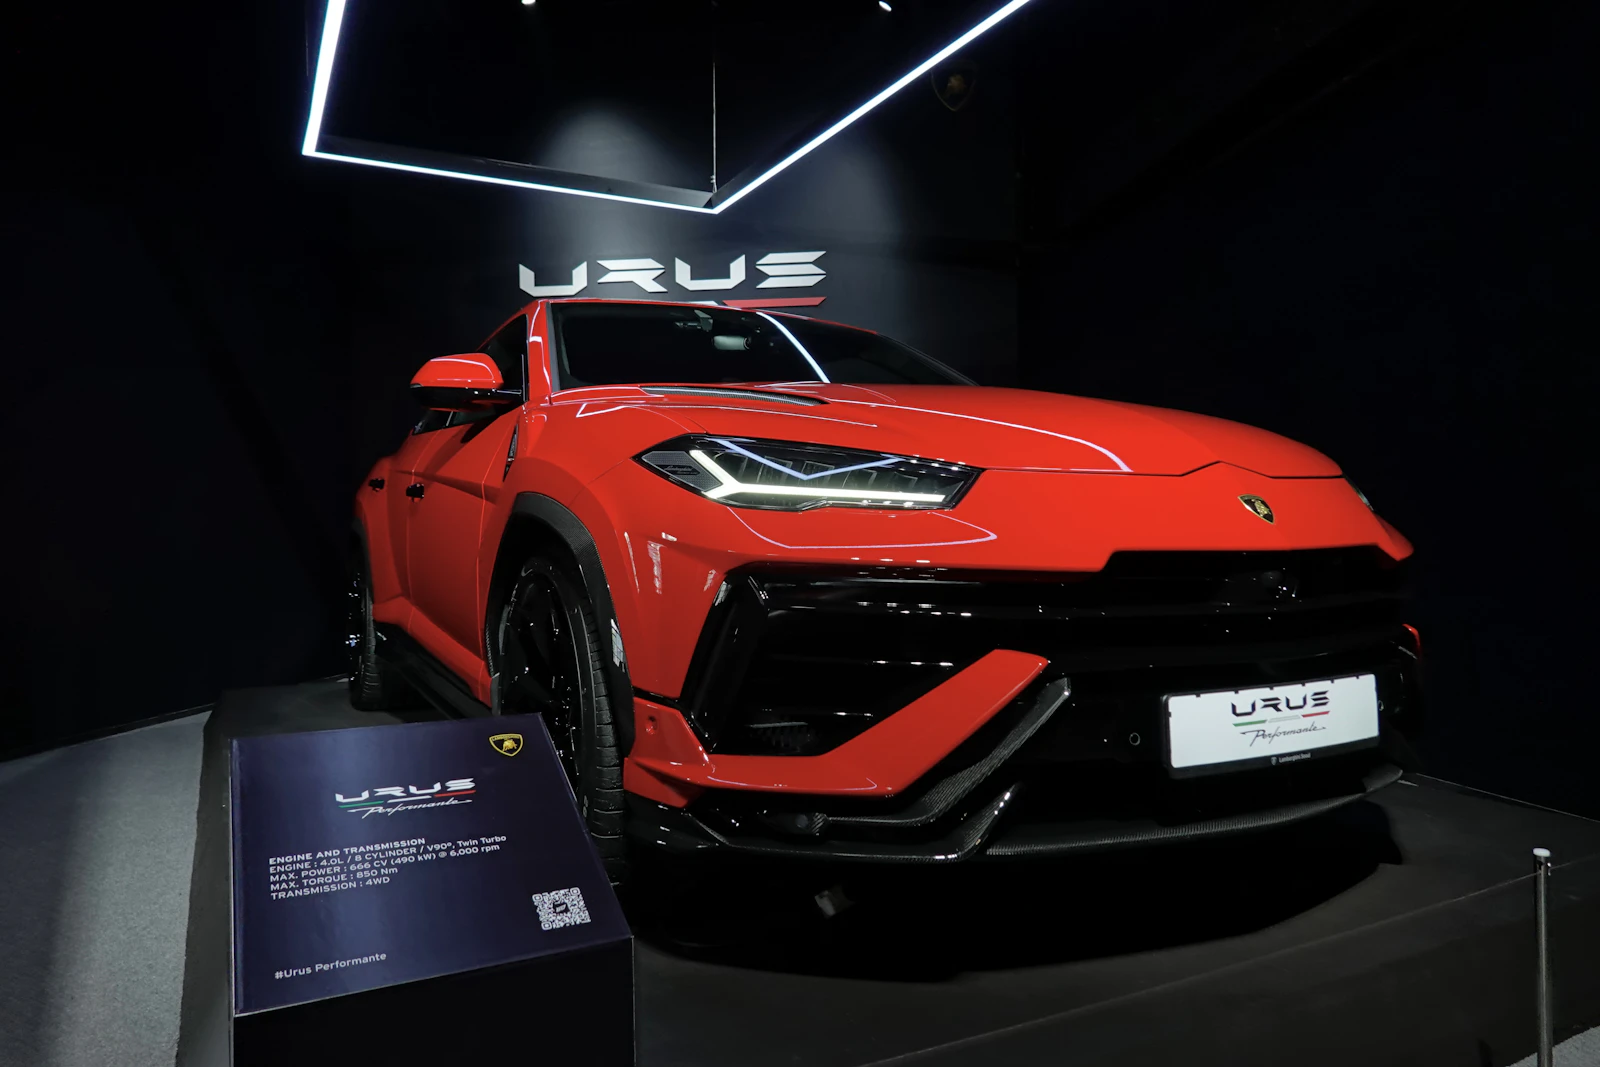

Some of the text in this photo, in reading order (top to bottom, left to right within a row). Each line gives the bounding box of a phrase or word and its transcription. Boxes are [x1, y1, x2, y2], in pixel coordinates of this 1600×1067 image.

[519, 251, 827, 297] URUS
[1231, 690, 1330, 717] URUS
[1240, 721, 1327, 747] Performante
[335, 778, 476, 803] URUS
[347, 797, 473, 819] Performante
[269, 838, 426, 865] ENGINE AND TRANSMISSION
[269, 861, 311, 874] ENGINE
[320, 858, 344, 866] 4.0L
[354, 854, 362, 862] 8
[364, 847, 417, 860] CYLINDER
[457, 839, 478, 847] Twin
[480, 835, 507, 844] Turbo
[270, 872, 298, 882] MAX.
[301, 866, 341, 878] POWER
[350, 862, 371, 871] 666
[373, 859, 388, 867] CV
[390, 855, 415, 866] (490
[417, 853, 436, 861] kW)
[449, 846, 479, 857] 6,000
[481, 844, 500, 853] rpm
[270, 881, 299, 891] MAX.
[302, 873, 348, 886] TORQUE
[356, 869, 378, 879] 850
[381, 867, 398, 875] Nm
[270, 881, 357, 900] TRANSMISSION
[365, 876, 390, 886] 4WD
[274, 953, 387, 979] #Urus Performante
